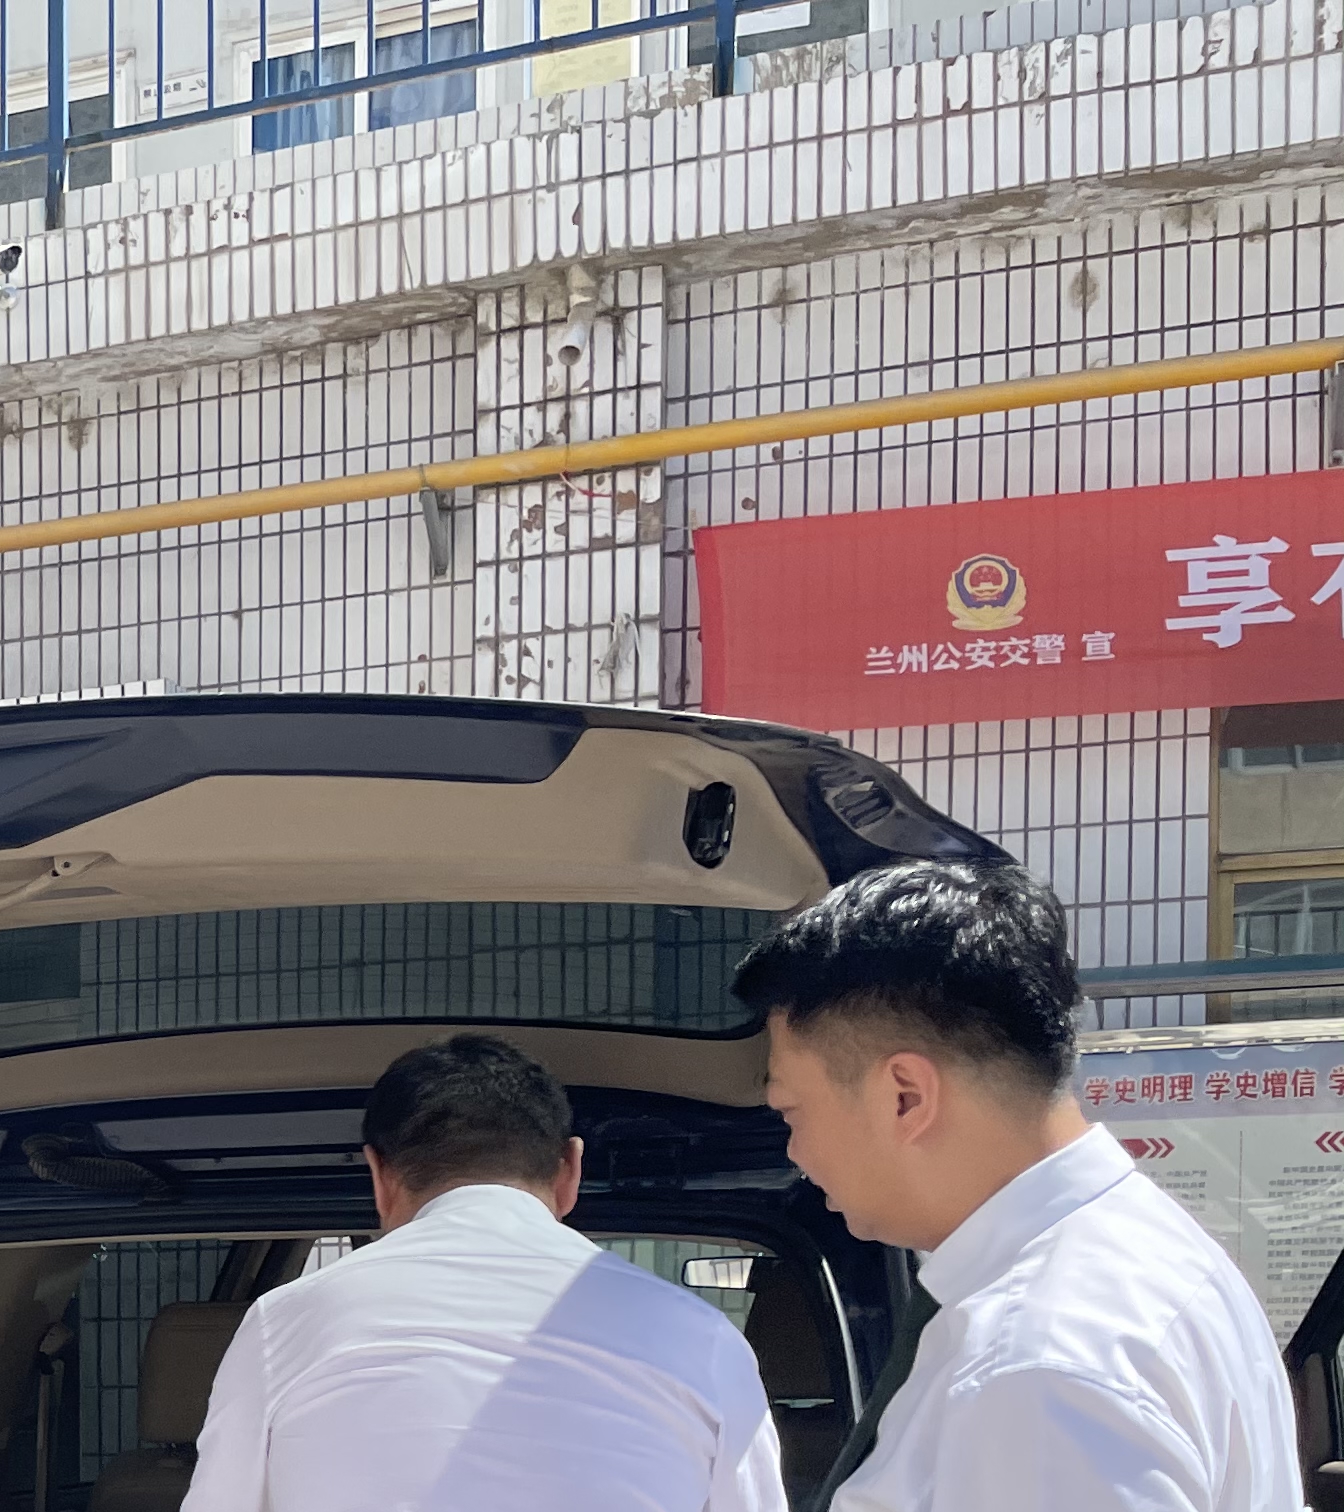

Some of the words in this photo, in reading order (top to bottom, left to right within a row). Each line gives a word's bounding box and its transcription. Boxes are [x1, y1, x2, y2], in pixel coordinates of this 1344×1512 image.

[1165, 534, 1344, 648] 享
[864, 633, 1066, 675] 兰州公安交警
[1081, 630, 1116, 661] 宣
[1085, 1073, 1194, 1106] 学史明理
[1205, 1067, 1316, 1101] 学史增信
